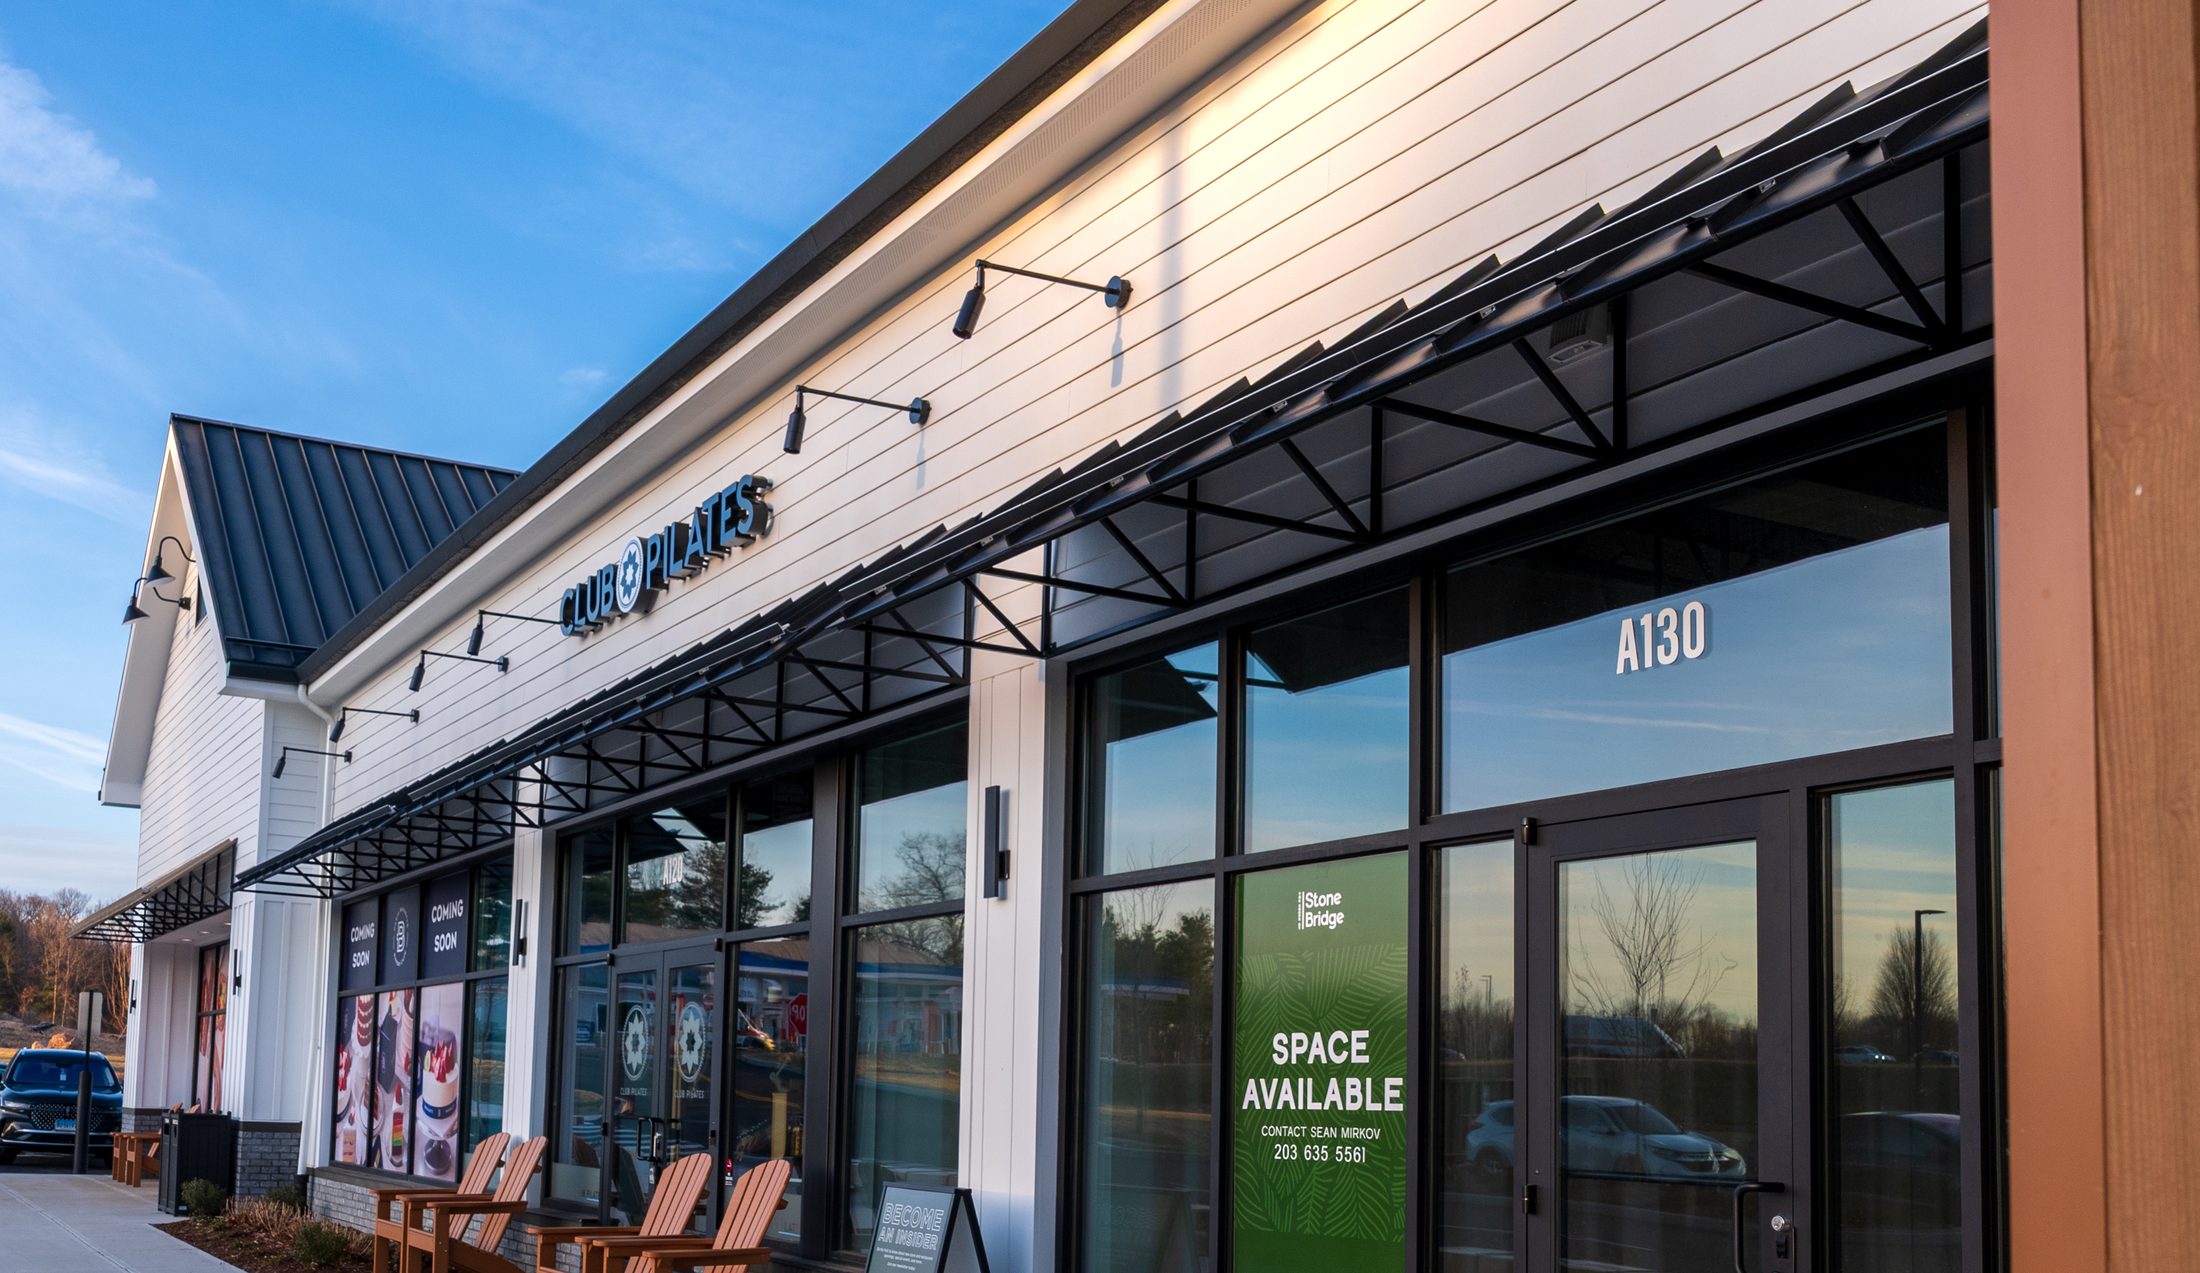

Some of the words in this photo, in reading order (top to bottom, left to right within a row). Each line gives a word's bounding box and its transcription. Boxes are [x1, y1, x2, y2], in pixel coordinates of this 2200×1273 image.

[560, 563, 617, 636] CLUB
[646, 474, 756, 590] PILATES
[1616, 601, 1705, 675] A130
[663, 855, 683, 885] A120
[431, 899, 464, 923] COMING
[1305, 892, 1342, 909] Stone
[351, 922, 375, 942] COMING
[1305, 910, 1345, 930] Bridge
[434, 931, 457, 952] SOON
[352, 950, 370, 968] SOON
[1272, 1030, 1370, 1065] SPACE
[1242, 1077, 1404, 1112] AVAILABLE
[1261, 1125, 1307, 1137] CONTACT
[1310, 1126, 1337, 1138] SEAN
[1341, 1127, 1381, 1140] MIRKOV
[1274, 1143, 1298, 1160] 203
[1304, 1144, 1329, 1161] 635
[1335, 1146, 1366, 1163] 5561
[882, 1202, 945, 1232] BECOME
[877, 1226, 895, 1244] AN
[895, 1228, 939, 1251] INSIDER
